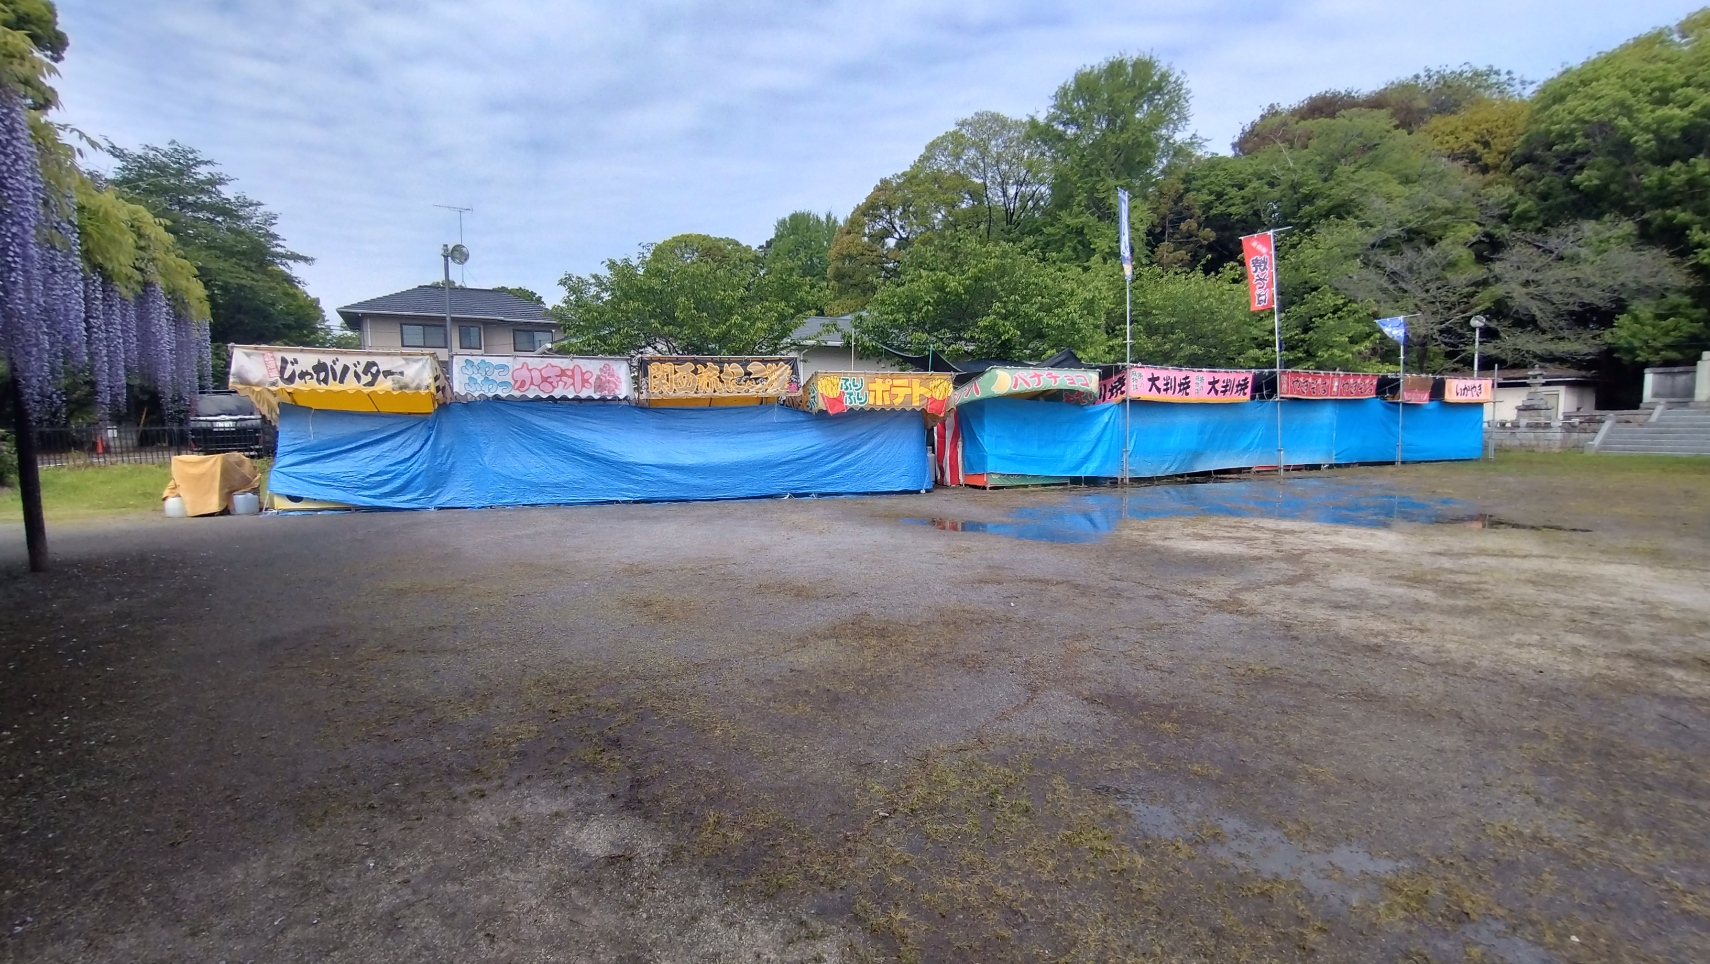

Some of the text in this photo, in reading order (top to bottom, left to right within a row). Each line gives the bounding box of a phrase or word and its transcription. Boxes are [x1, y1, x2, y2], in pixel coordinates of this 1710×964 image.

[279, 356, 405, 387] じゃがバター
[512, 362, 593, 394] かき氷
[1012, 371, 1091, 389] バナチョコ
[868, 378, 931, 406] ポテト
[1147, 373, 1191, 396] 大判焼
[1207, 376, 1249, 396] 大判焼
[1456, 384, 1482, 398] いかやき
